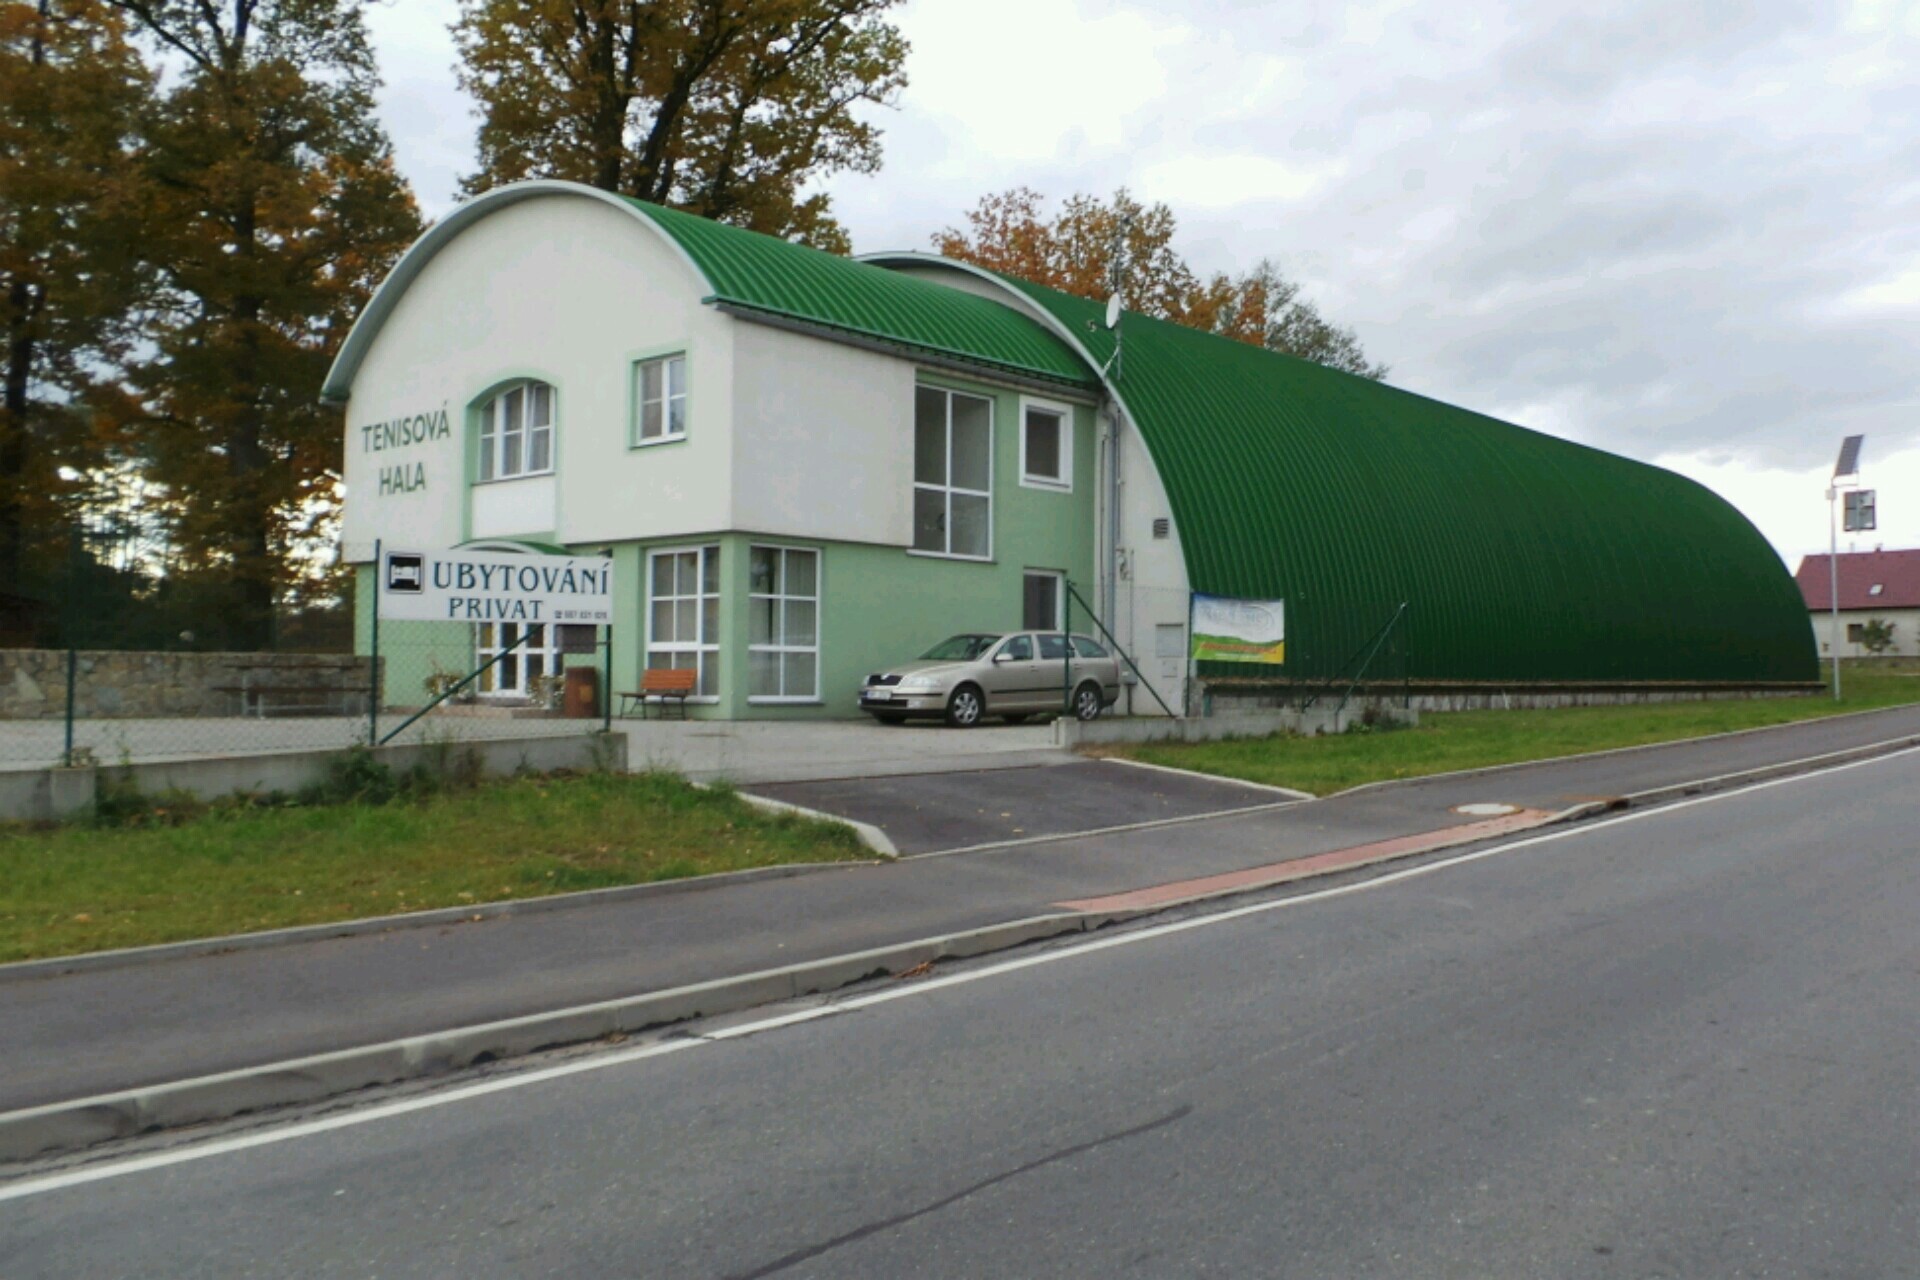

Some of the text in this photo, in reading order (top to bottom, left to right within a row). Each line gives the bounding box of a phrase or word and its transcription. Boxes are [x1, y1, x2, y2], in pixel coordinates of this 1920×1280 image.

[361, 399, 450, 453] TENISOVÁ
[379, 461, 426, 496] HALA
[433, 560, 610, 595] UBYTOVÁNÍ
[449, 598, 543, 619] PRIVAT
